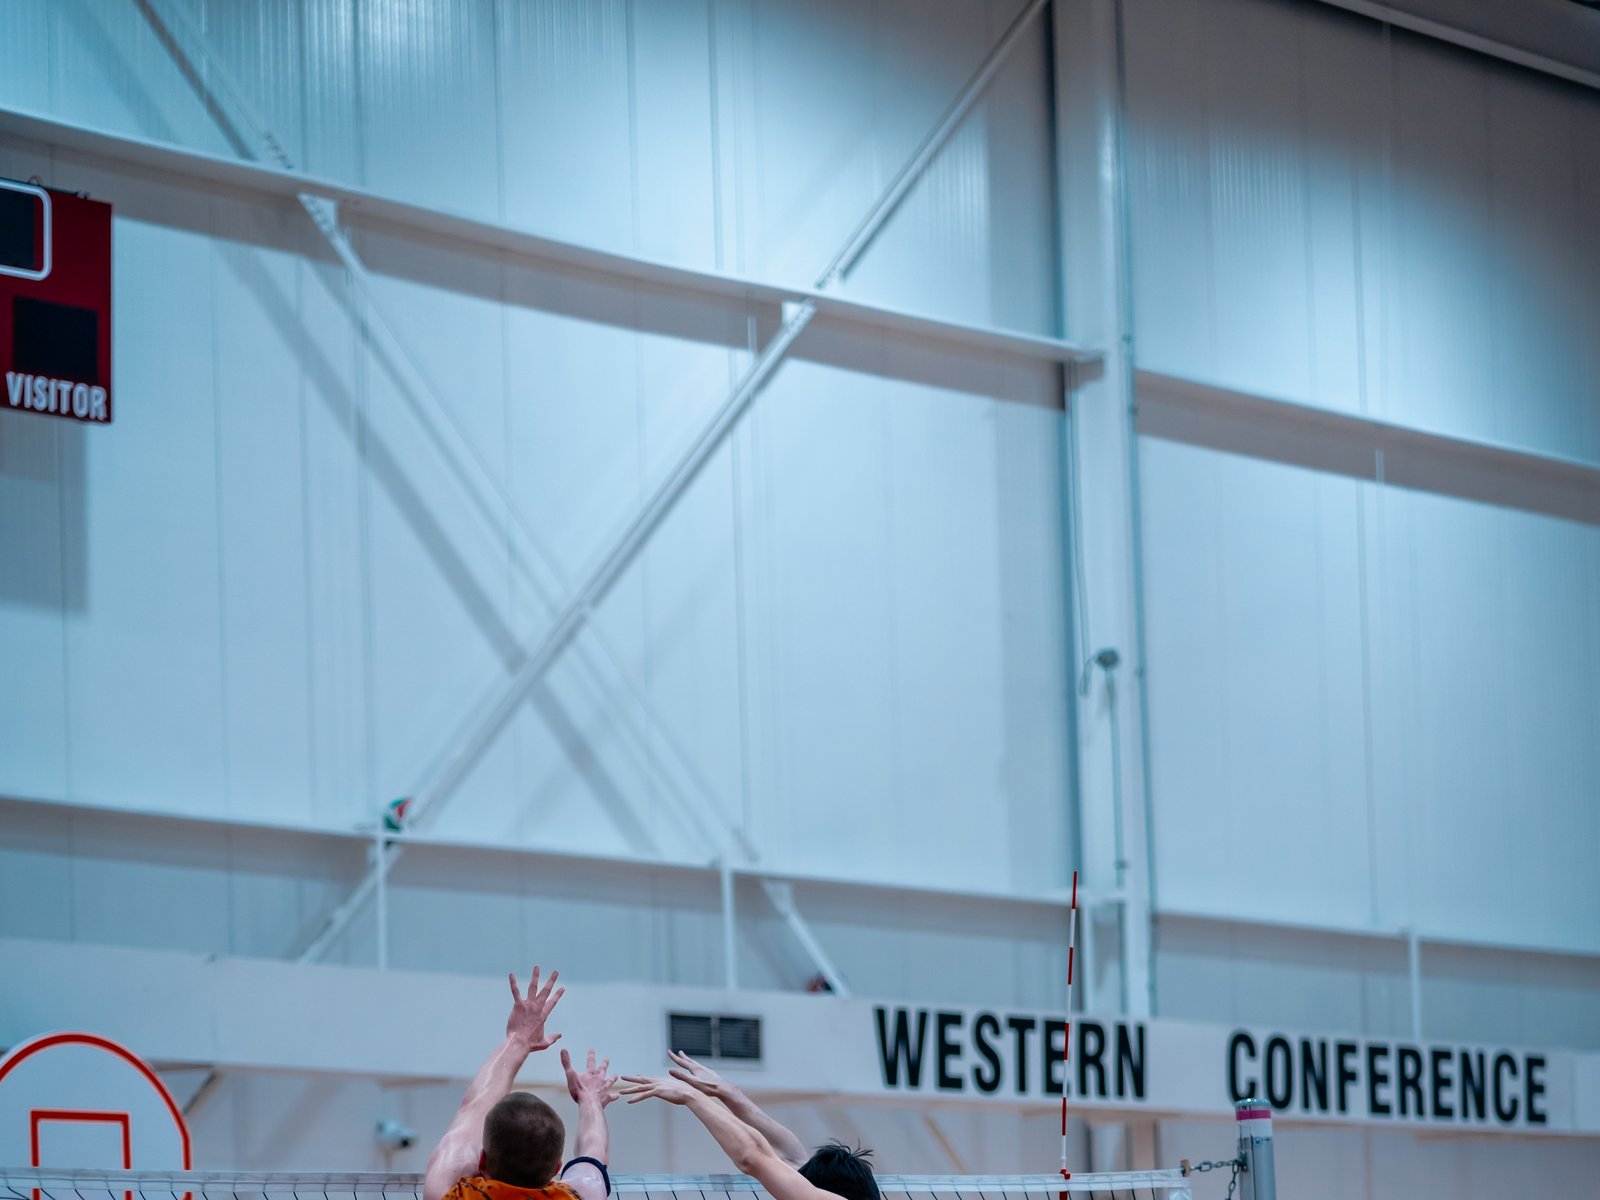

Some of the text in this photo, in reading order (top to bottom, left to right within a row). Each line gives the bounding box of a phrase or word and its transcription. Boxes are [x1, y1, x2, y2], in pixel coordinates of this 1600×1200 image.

[5, 371, 108, 421] VISITOR
[874, 1007, 1146, 1098] WESTERN
[1228, 1032, 1547, 1124] CONFERENCE
